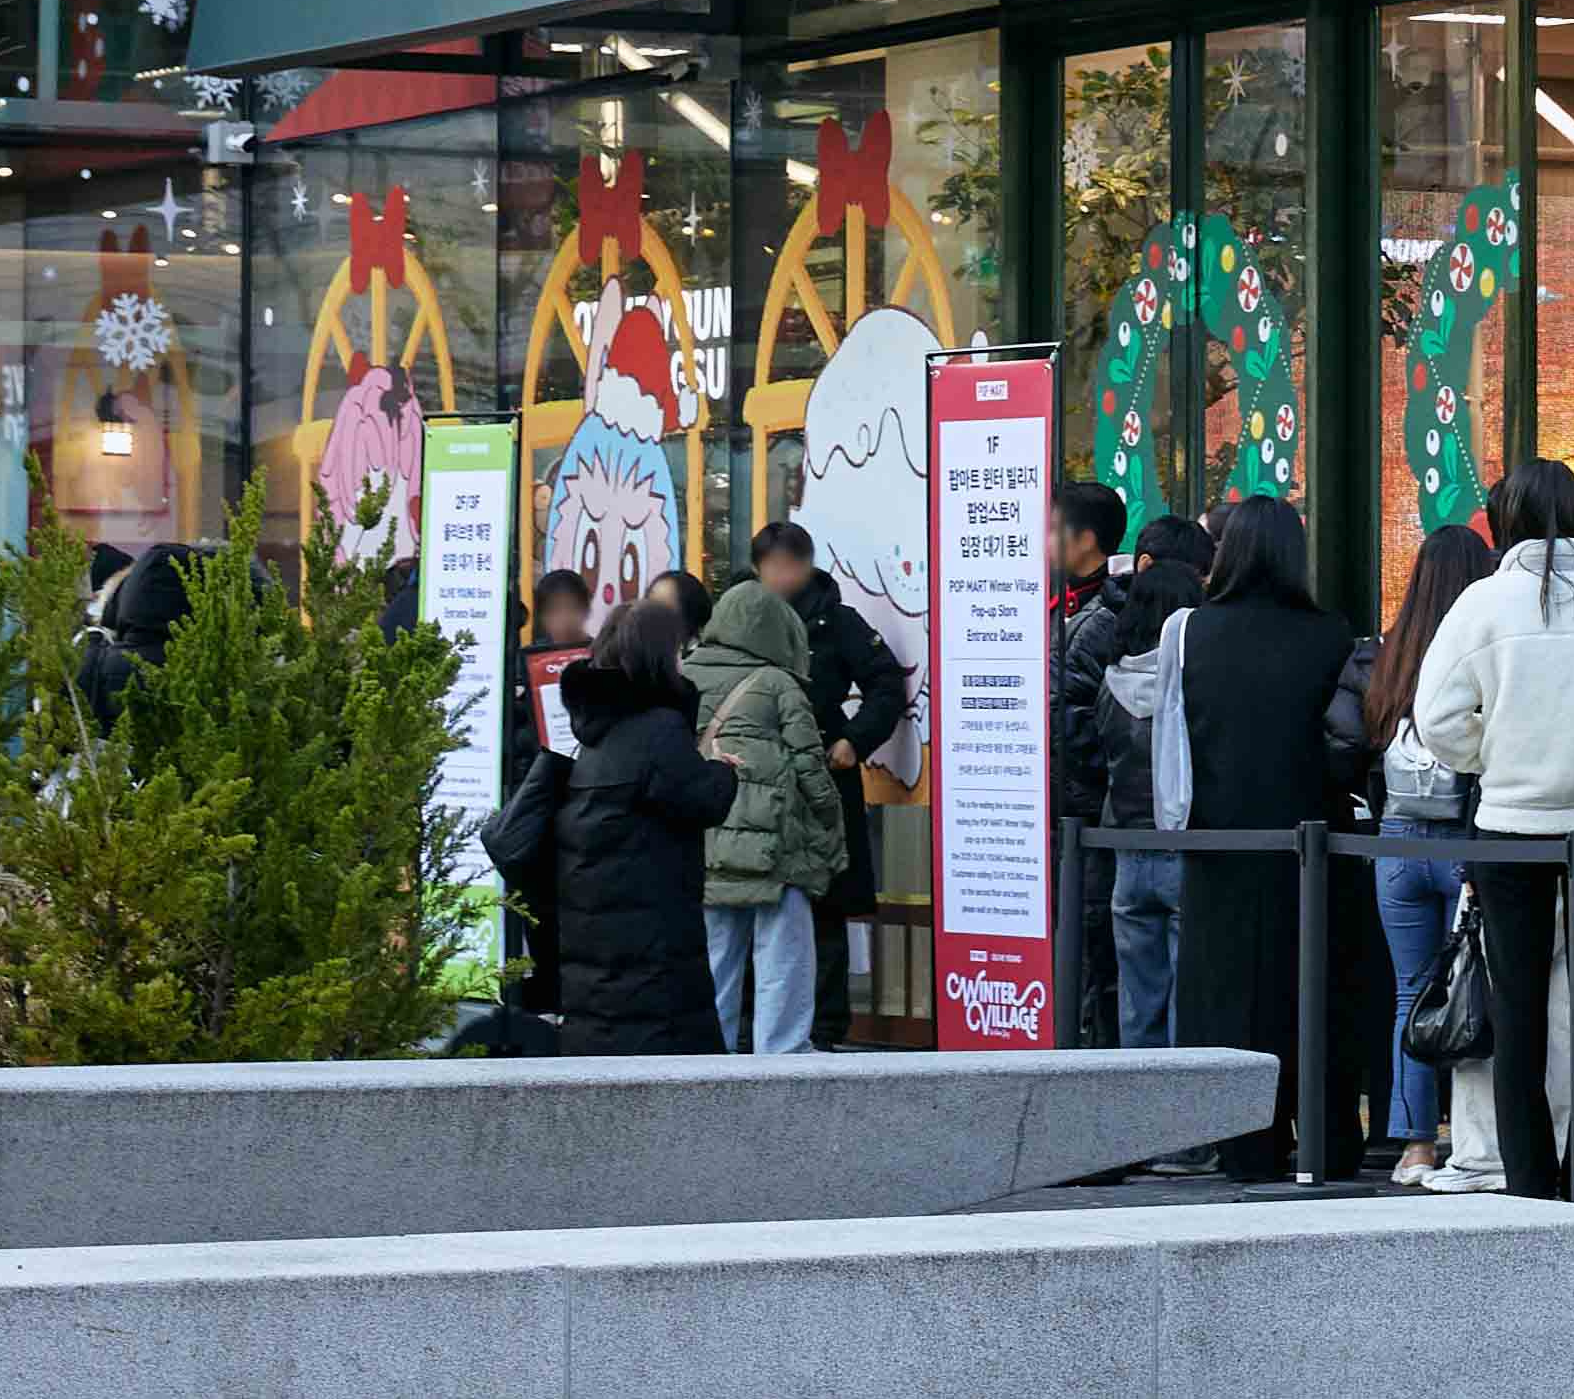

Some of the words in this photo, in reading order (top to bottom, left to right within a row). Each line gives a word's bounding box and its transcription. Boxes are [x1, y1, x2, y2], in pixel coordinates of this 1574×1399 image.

[987, 435, 1000, 455] 1F
[949, 468, 980, 491] 팝마트
[1007, 465, 1038, 490] 빌리지
[967, 501, 1020, 524] 팝업스토어
[960, 536, 981, 558] 입장
[983, 536, 1005, 558] 대기
[946, 969, 1046, 1009] WINTER
[966, 1000, 1038, 1041] VILLAGE
